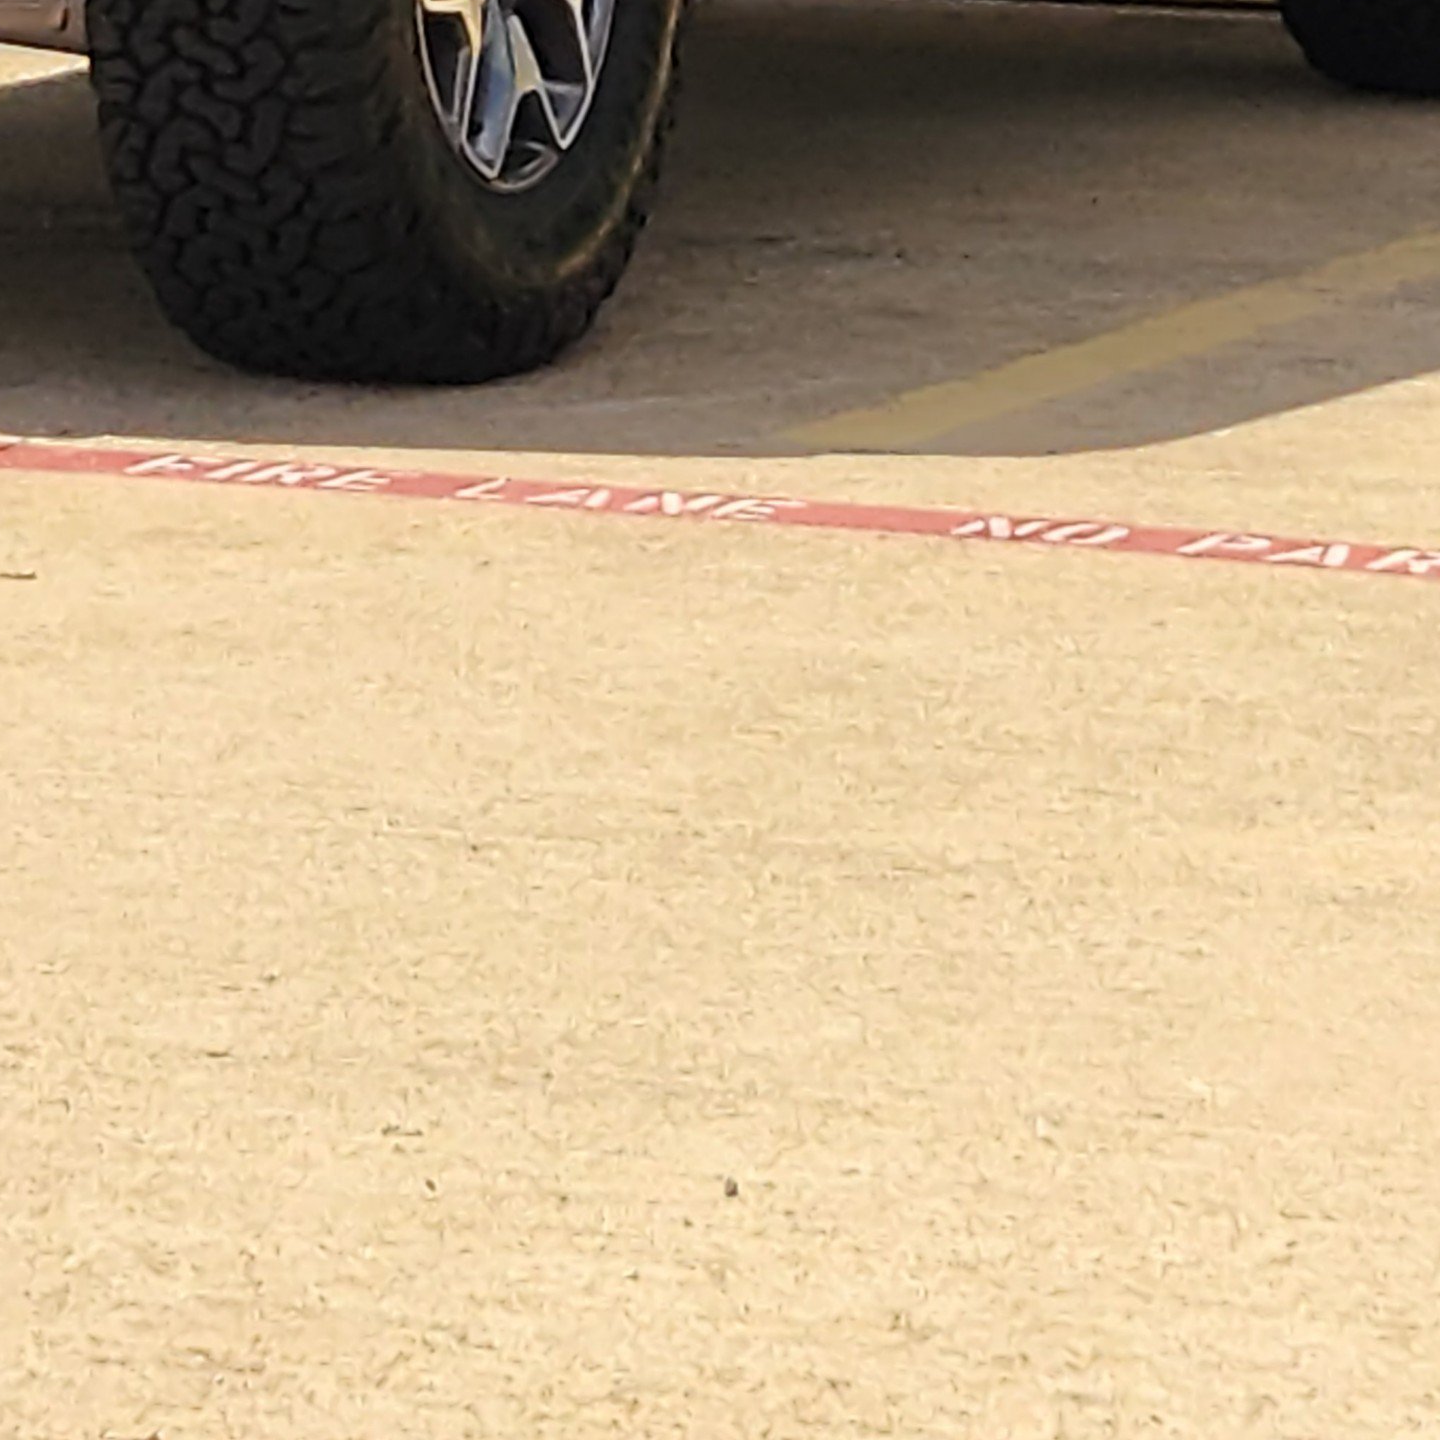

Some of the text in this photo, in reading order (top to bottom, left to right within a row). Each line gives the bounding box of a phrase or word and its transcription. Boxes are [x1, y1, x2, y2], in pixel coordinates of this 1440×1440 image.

[123, 452, 405, 492] FIRE
[453, 476, 808, 520] LANE
[951, 514, 1131, 547] NO
